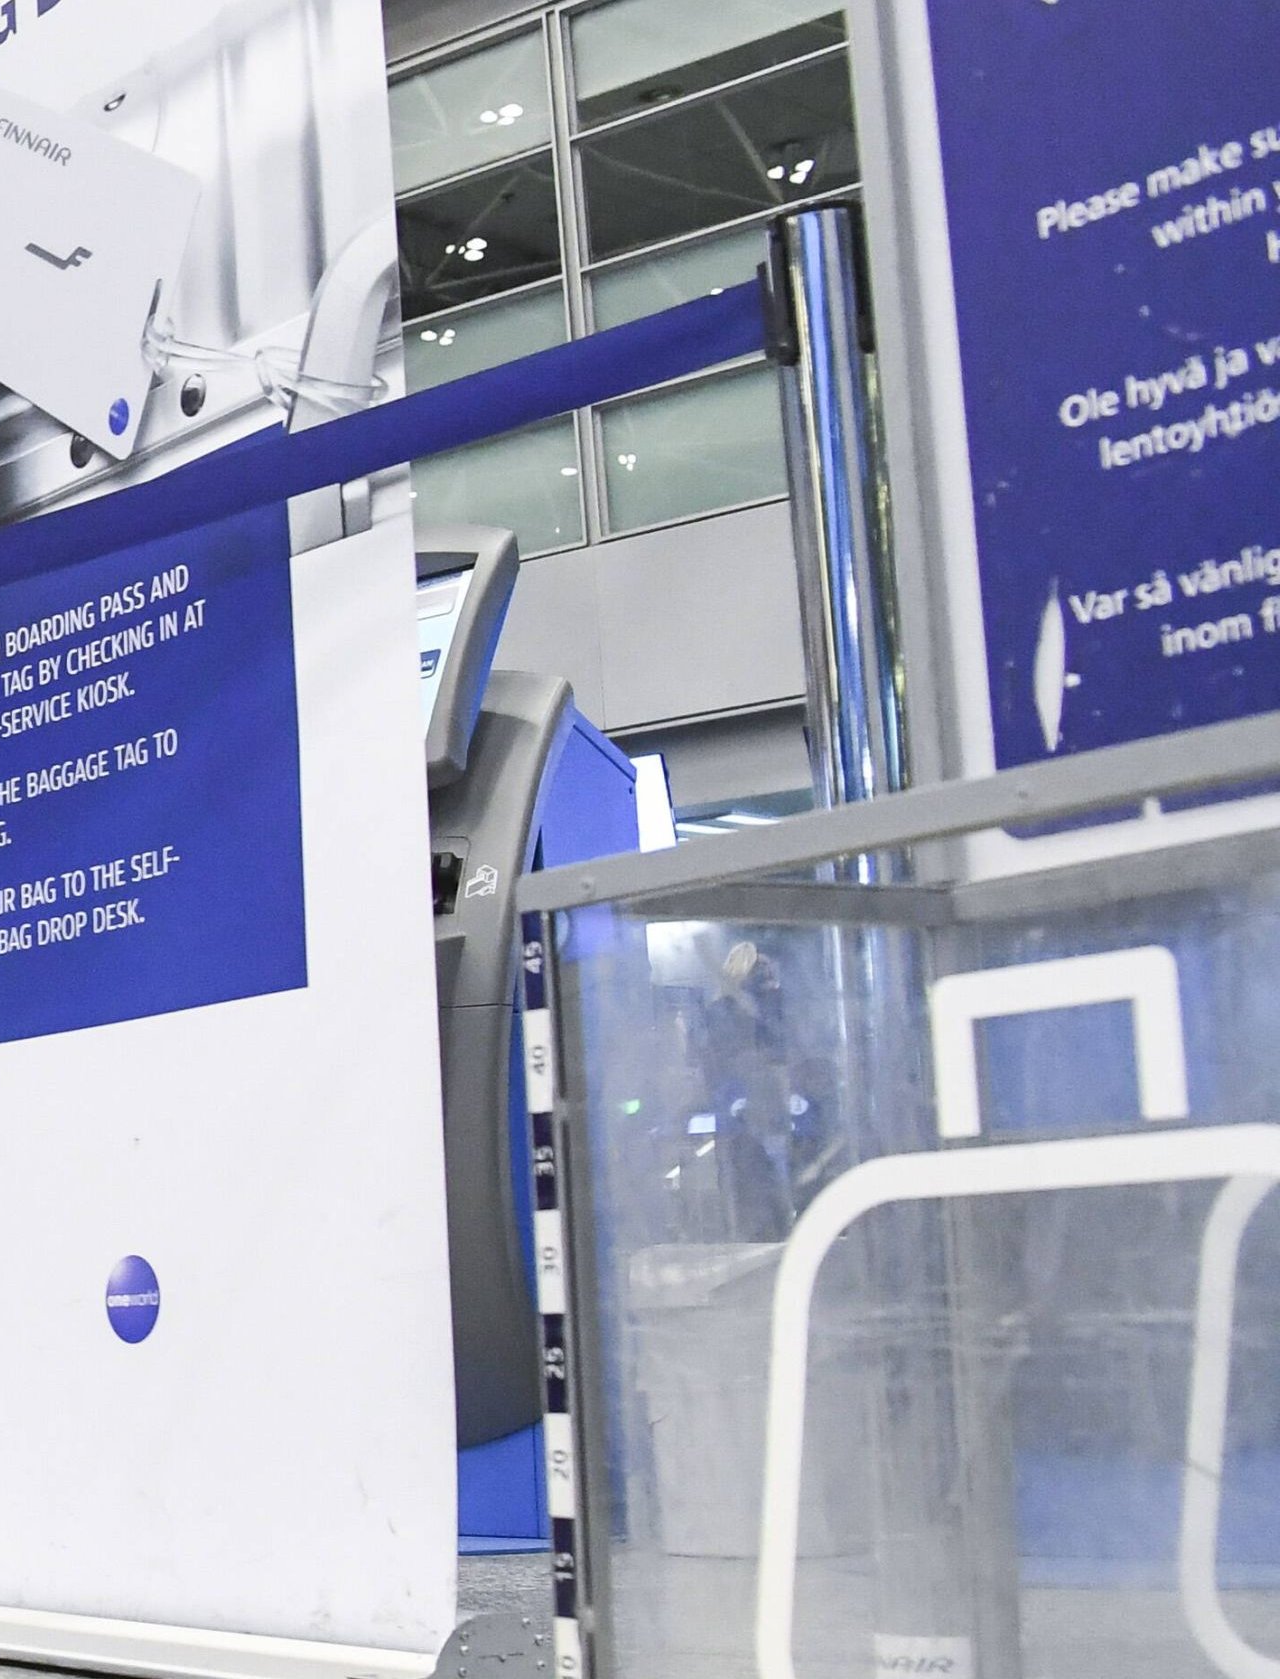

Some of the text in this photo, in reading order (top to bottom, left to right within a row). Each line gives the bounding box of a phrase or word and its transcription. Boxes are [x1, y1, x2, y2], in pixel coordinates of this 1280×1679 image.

[1036, 182, 1140, 240] Please
[1146, 141, 1243, 198] make
[1152, 187, 1267, 249] within
[1059, 387, 1120, 427] Ole
[1125, 355, 1207, 411] hyvä
[1213, 346, 1249, 390] ja
[1099, 387, 1280, 470] lentoyhtiö
[6, 602, 95, 657] BOARDING
[101, 582, 145, 622] PASS
[150, 564, 189, 602] AND
[1068, 588, 1128, 624] Var
[1134, 569, 1173, 610] så
[1, 665, 33, 697] TAG
[39, 655, 61, 686] BY
[66, 621, 154, 675] CHECKING
[160, 611, 178, 642] IN
[183, 599, 206, 632] AT
[1160, 612, 1254, 657] inom
[77, 672, 135, 712] KIOSK.
[27, 750, 109, 798] BAGGAGE
[114, 738, 148, 771] TAG
[152, 728, 178, 759] TO
[21, 877, 56, 909] BAG
[60, 870, 85, 899] TO
[90, 859, 125, 891] THE
[131, 846, 180, 882] SELF-
[37, 911, 87, 946] DROP
[93, 898, 145, 934] DESK.
[523, 941, 542, 974] 45
[532, 1045, 545, 1075] 40
[535, 1146, 554, 1177] 35
[544, 1347, 565, 1380] 25
[553, 1451, 569, 1480] 20
[555, 1553, 575, 1582] 15
